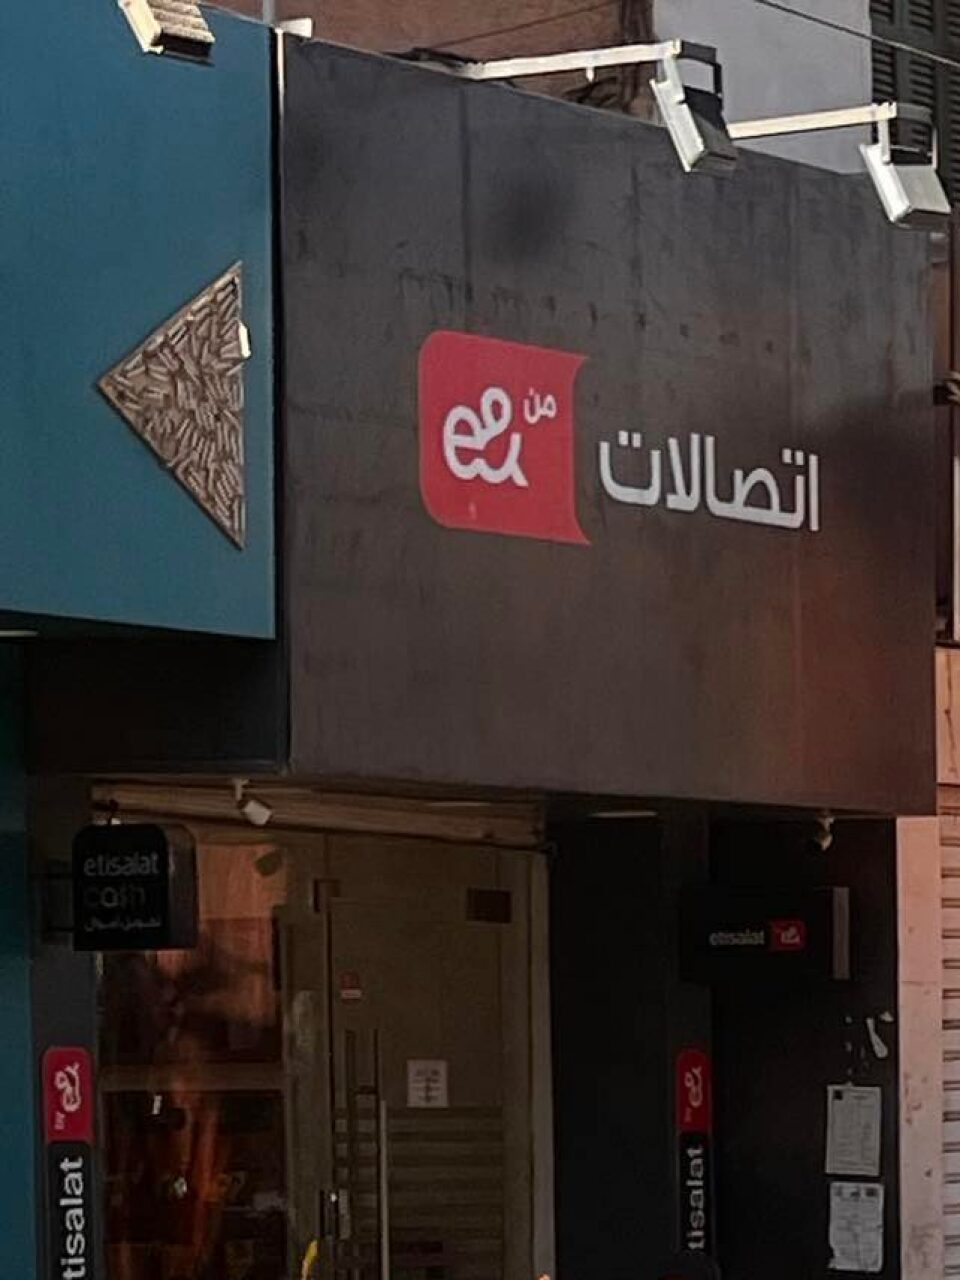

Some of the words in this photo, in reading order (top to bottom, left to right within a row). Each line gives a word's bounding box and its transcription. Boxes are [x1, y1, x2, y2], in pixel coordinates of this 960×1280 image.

[523, 387, 557, 424] من
[600, 430, 820, 532] اتصالات
[83, 850, 160, 876] etisalat
[686, 1145, 707, 1251] tisalat
